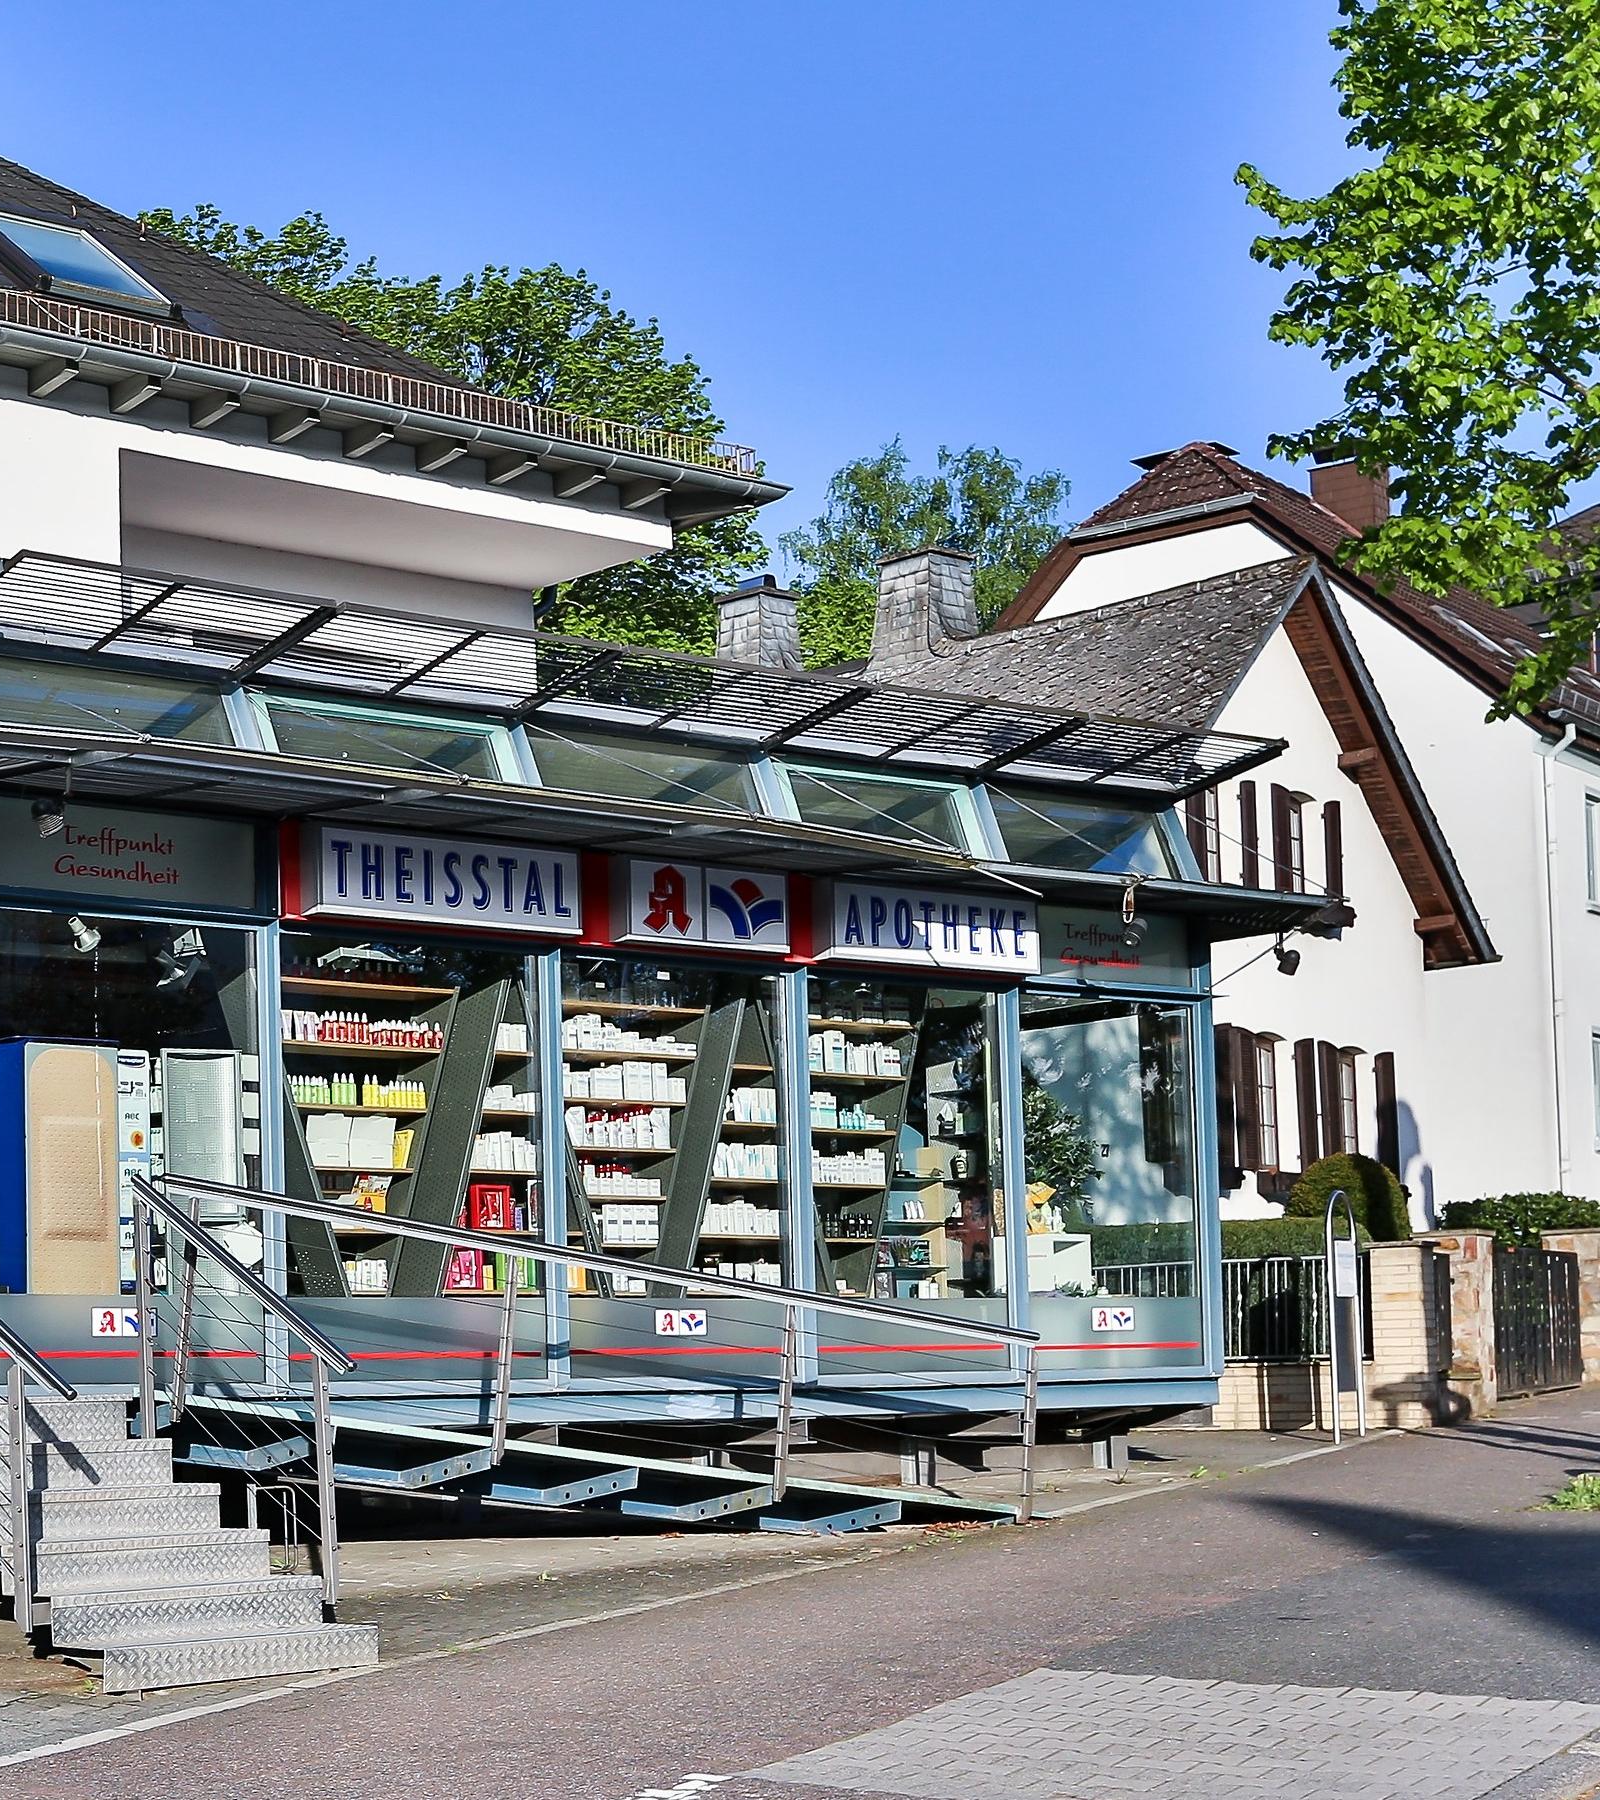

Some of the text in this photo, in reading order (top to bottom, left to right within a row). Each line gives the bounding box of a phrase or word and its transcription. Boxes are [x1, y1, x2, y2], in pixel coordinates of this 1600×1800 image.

[63, 824, 176, 856] Treffpunkt
[54, 854, 180, 885] Gesundheit
[331, 840, 572, 918] THEISSTAL
[845, 894, 1028, 958] APOTHEKE
